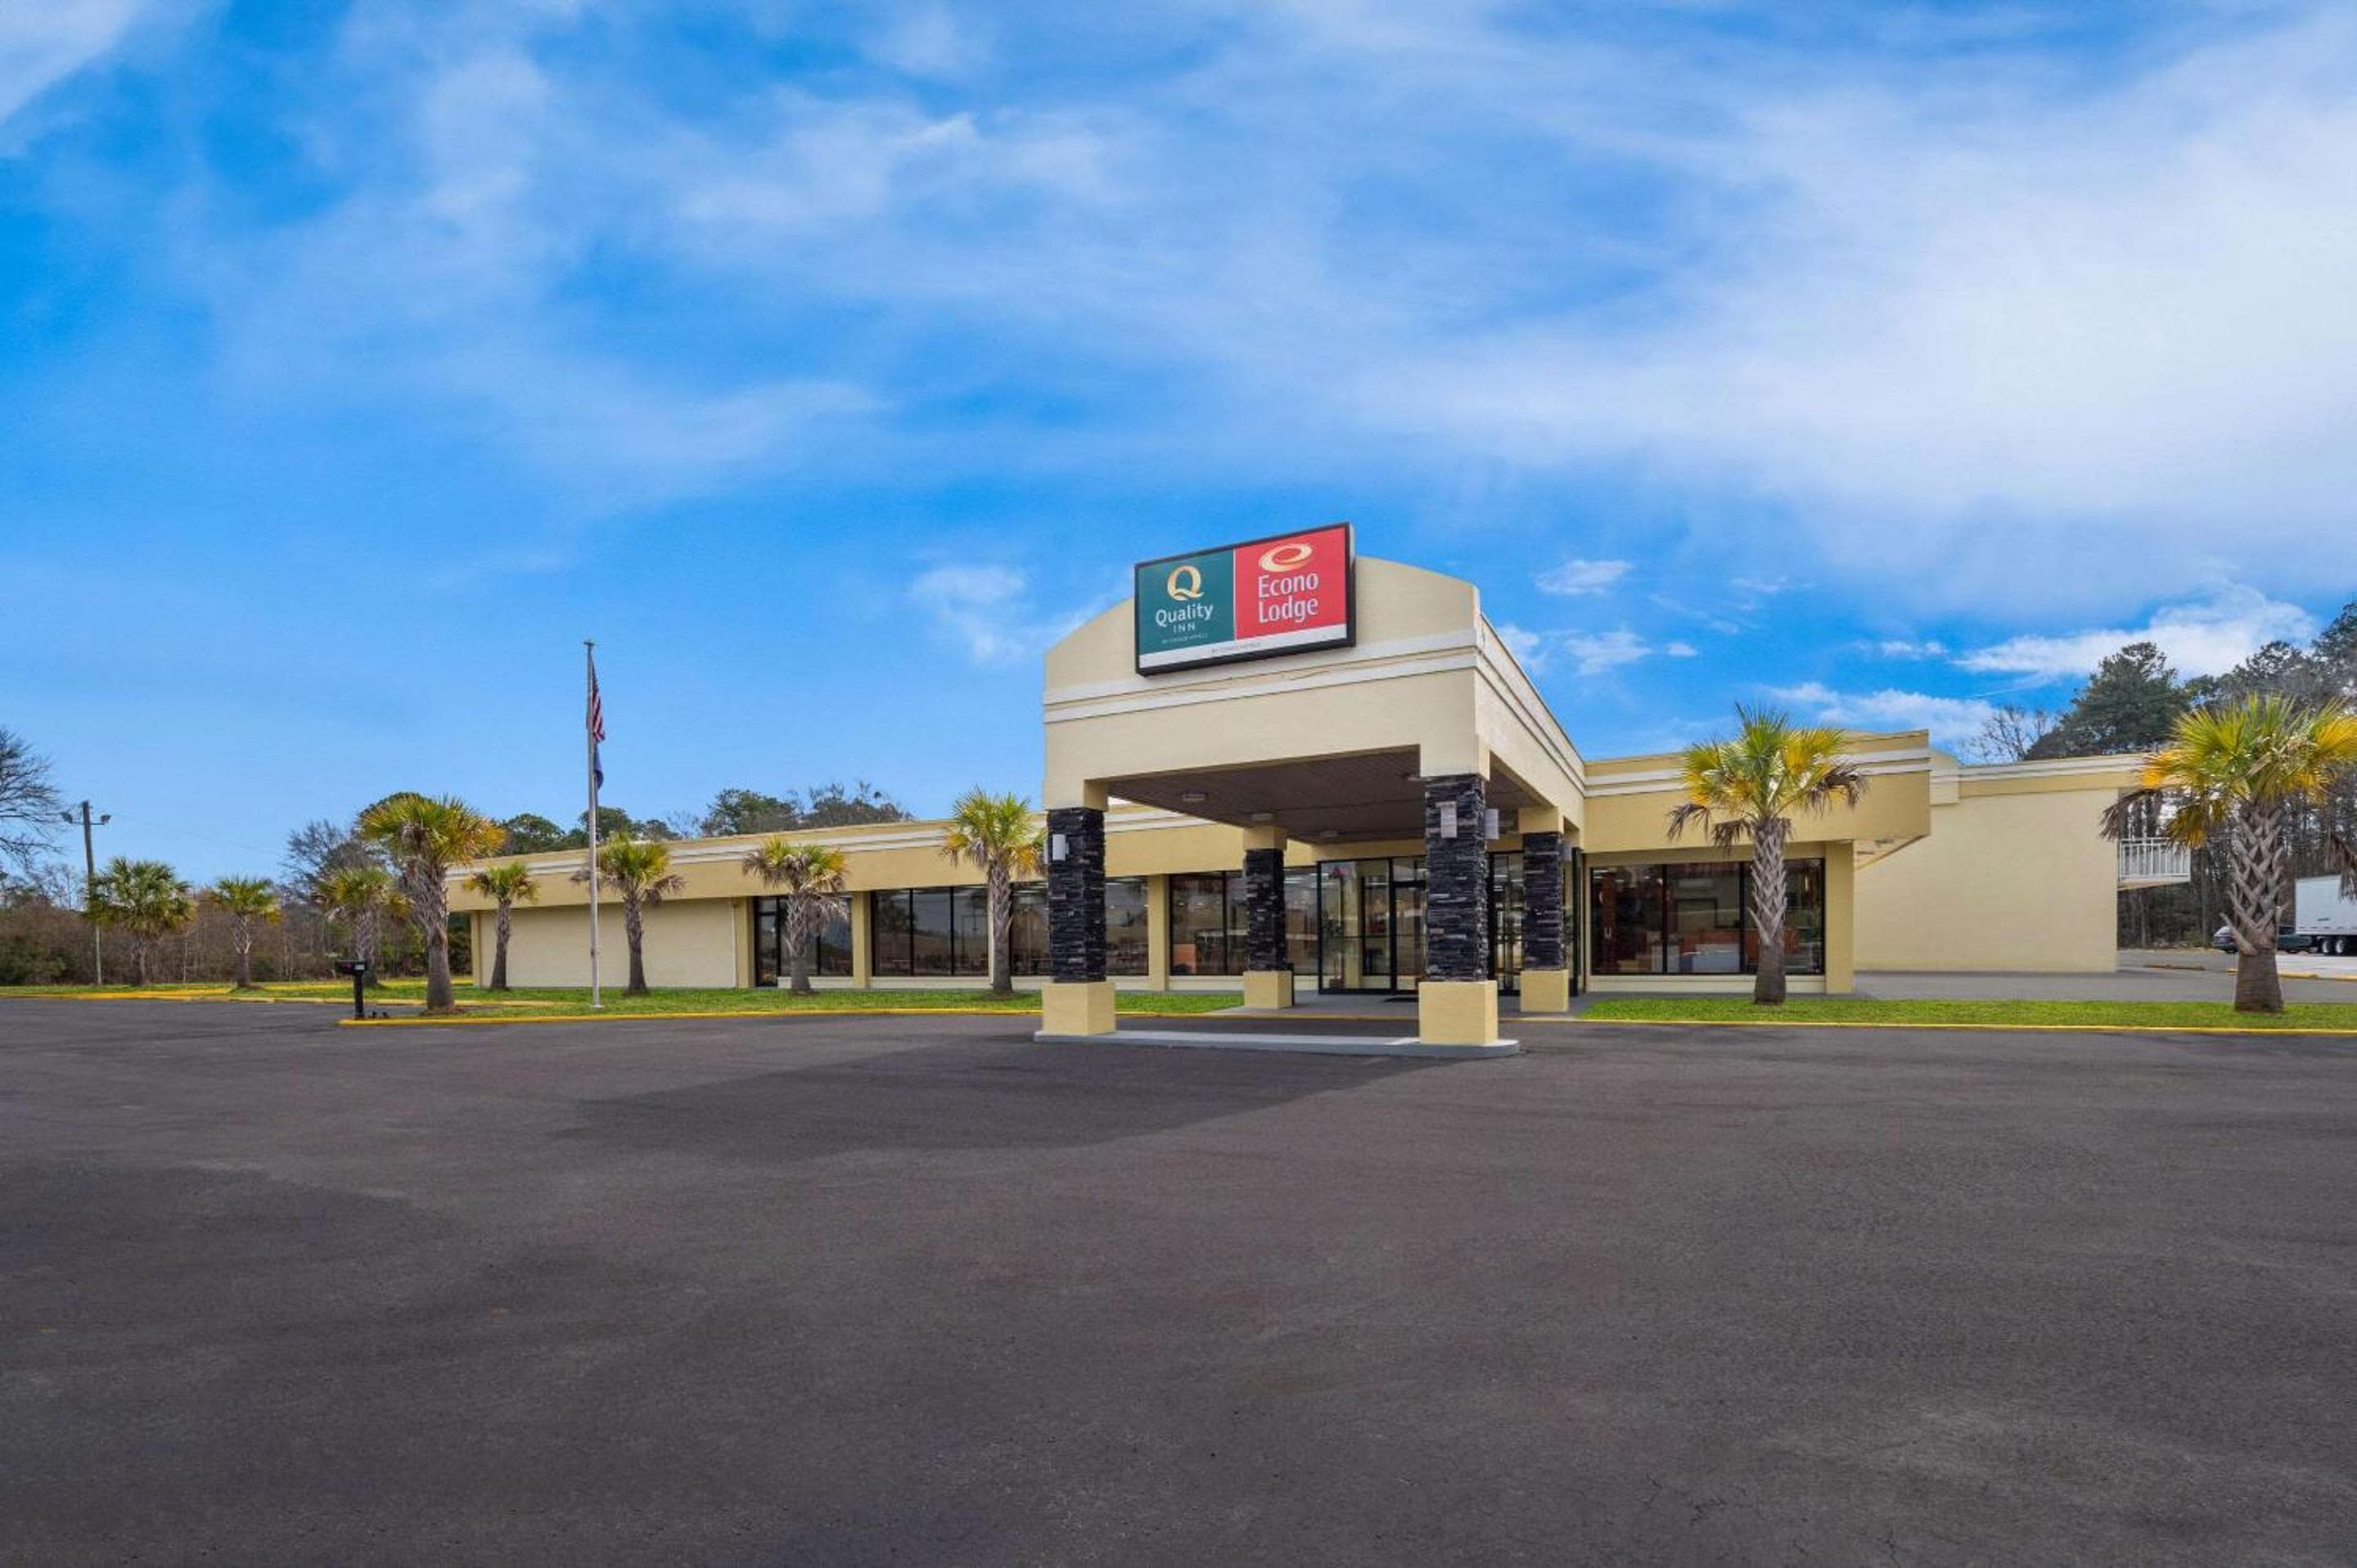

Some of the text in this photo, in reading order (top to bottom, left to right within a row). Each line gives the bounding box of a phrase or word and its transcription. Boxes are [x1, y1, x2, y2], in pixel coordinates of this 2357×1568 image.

[1167, 565, 1205, 601] Q
[1259, 573, 1318, 597] Econo
[1156, 603, 1214, 628] Quality
[1259, 596, 1318, 623] Lodge
[1173, 623, 1195, 634] INN
